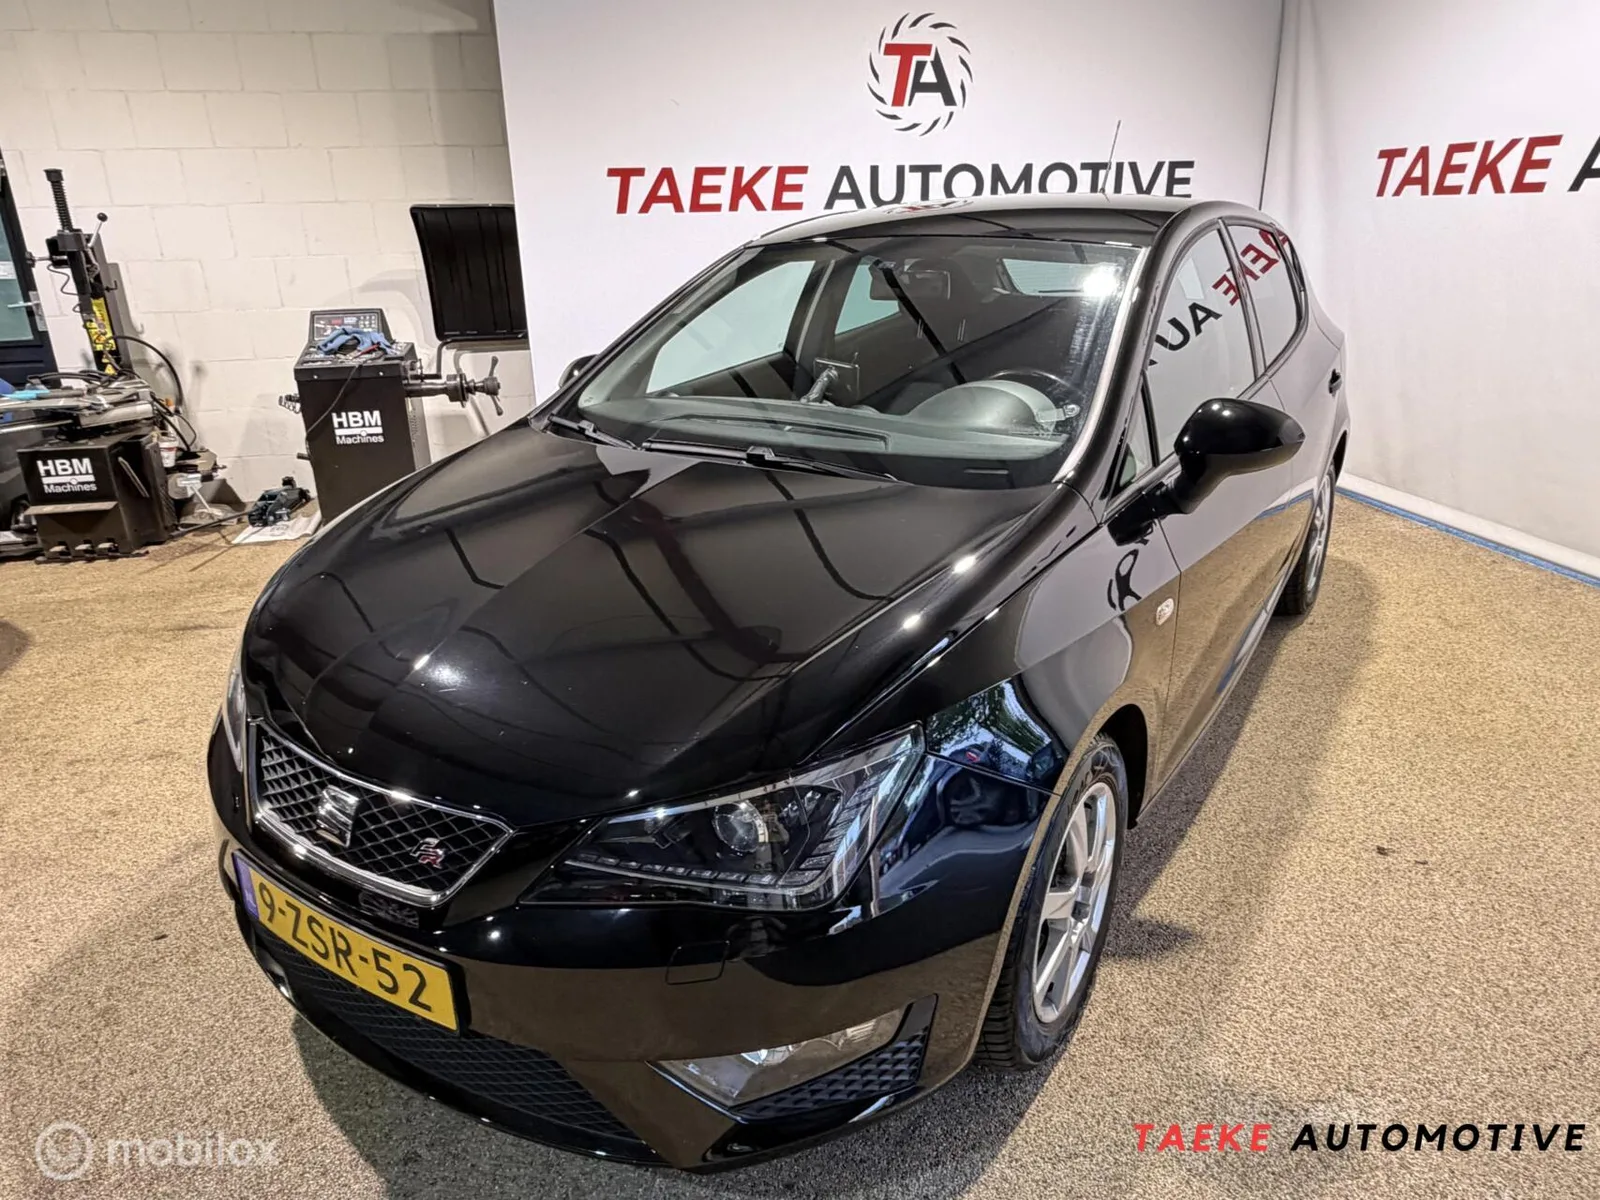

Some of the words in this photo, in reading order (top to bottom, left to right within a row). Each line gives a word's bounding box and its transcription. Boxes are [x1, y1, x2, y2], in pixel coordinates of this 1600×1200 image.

[882, 43, 958, 107] TA
[1376, 134, 1564, 198] TAEKE
[606, 165, 809, 215] TAEKE
[823, 160, 1196, 211] AUTOMOTIVE
[331, 410, 382, 428] HBM
[335, 435, 385, 445] Machines
[36, 457, 93, 476] HBM
[43, 483, 97, 494] Machines
[258, 881, 434, 1013] 9-ZSR-52
